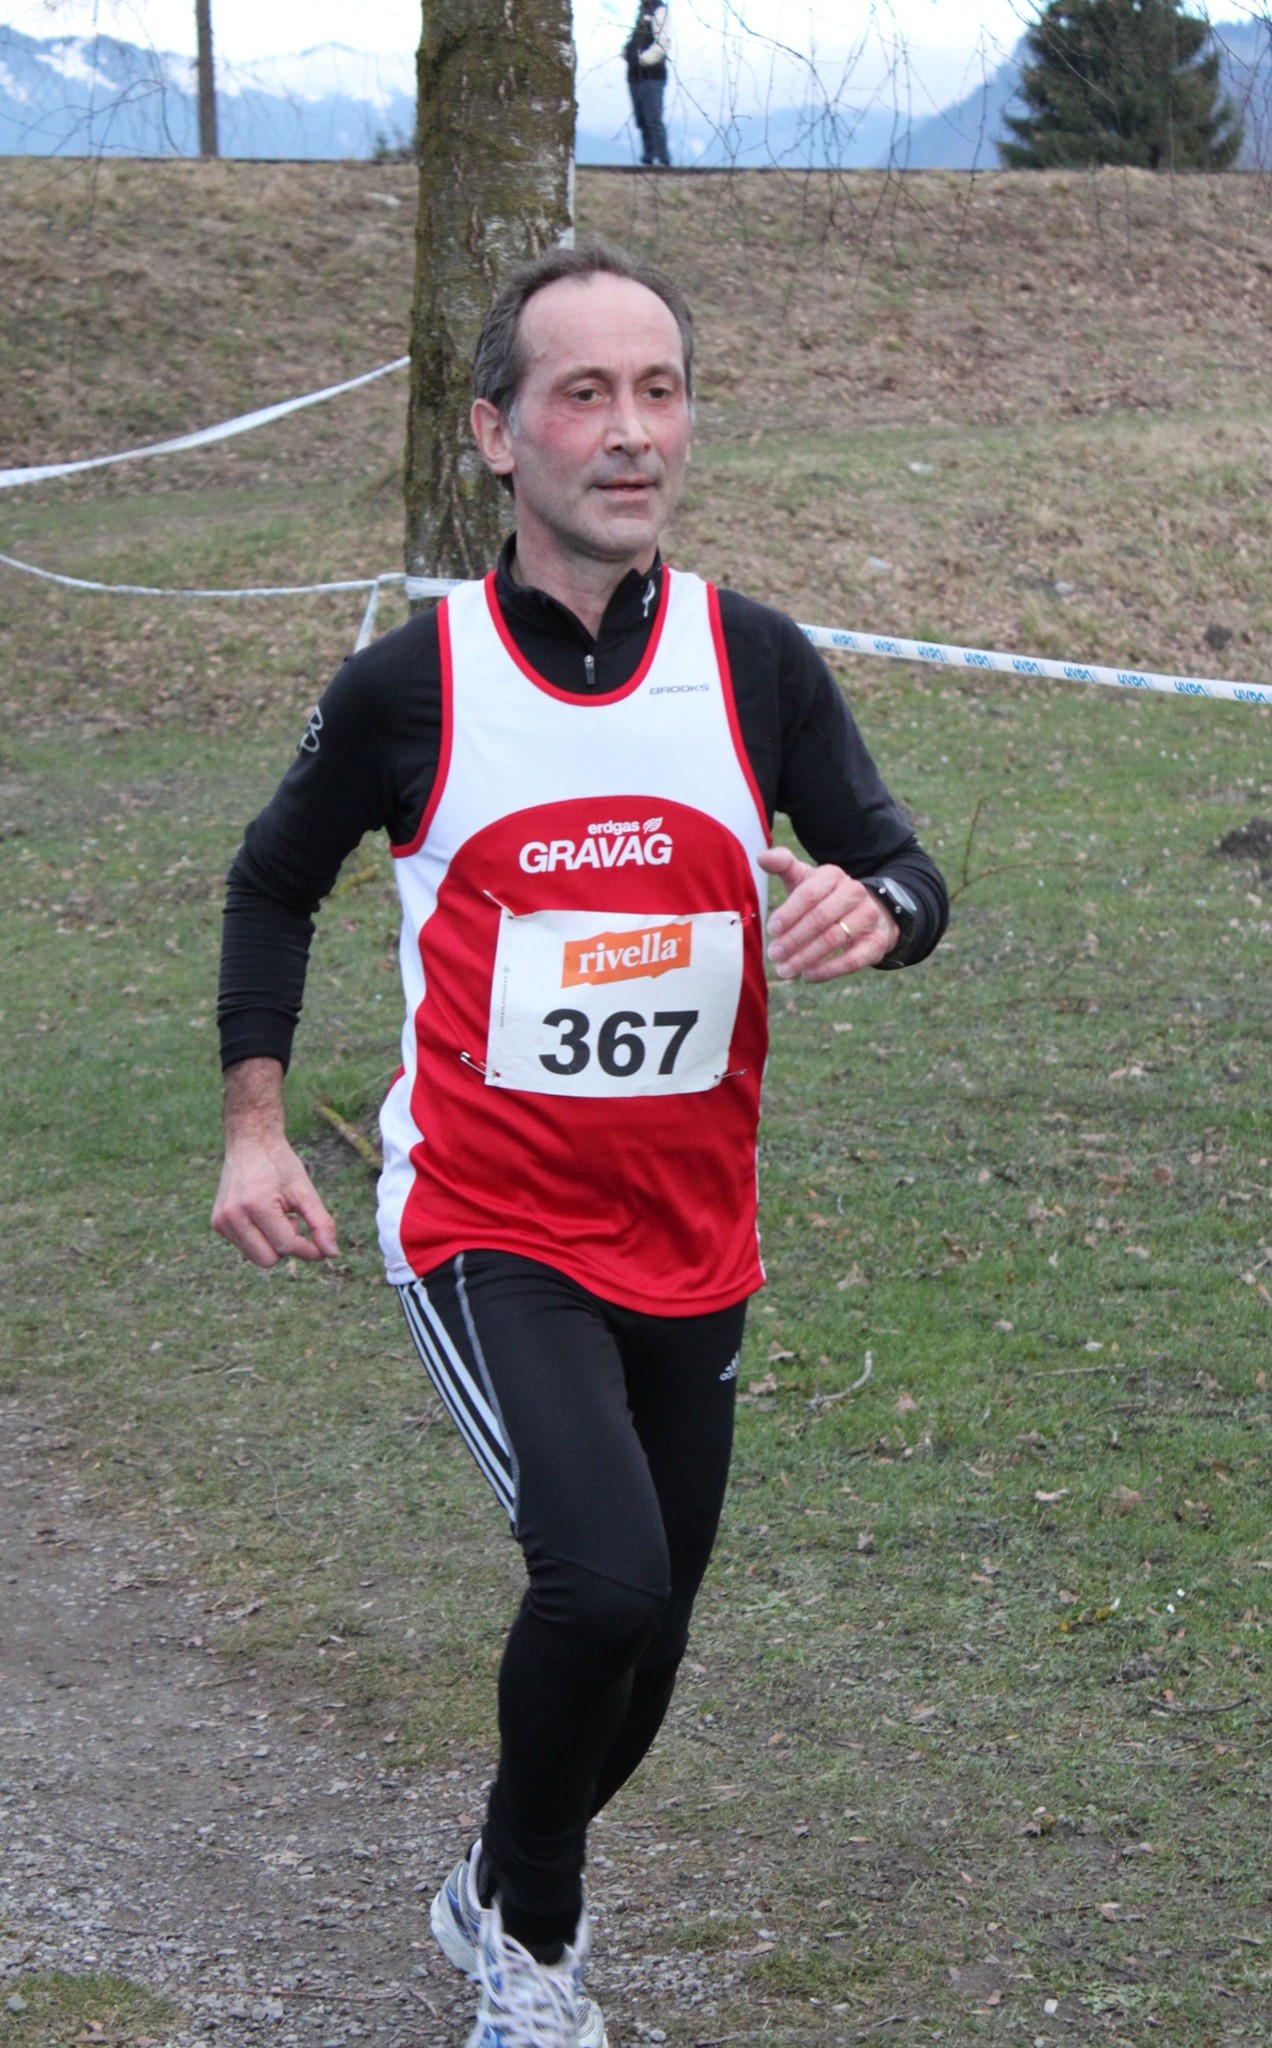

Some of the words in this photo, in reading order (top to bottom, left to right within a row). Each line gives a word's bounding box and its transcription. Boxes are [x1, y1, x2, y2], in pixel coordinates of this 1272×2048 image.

[649, 684, 709, 695] BROOKS
[588, 818, 640, 836] erdgas
[519, 832, 673, 873] GRAVAG
[578, 931, 679, 975] rivella
[539, 1008, 699, 1077] 367
